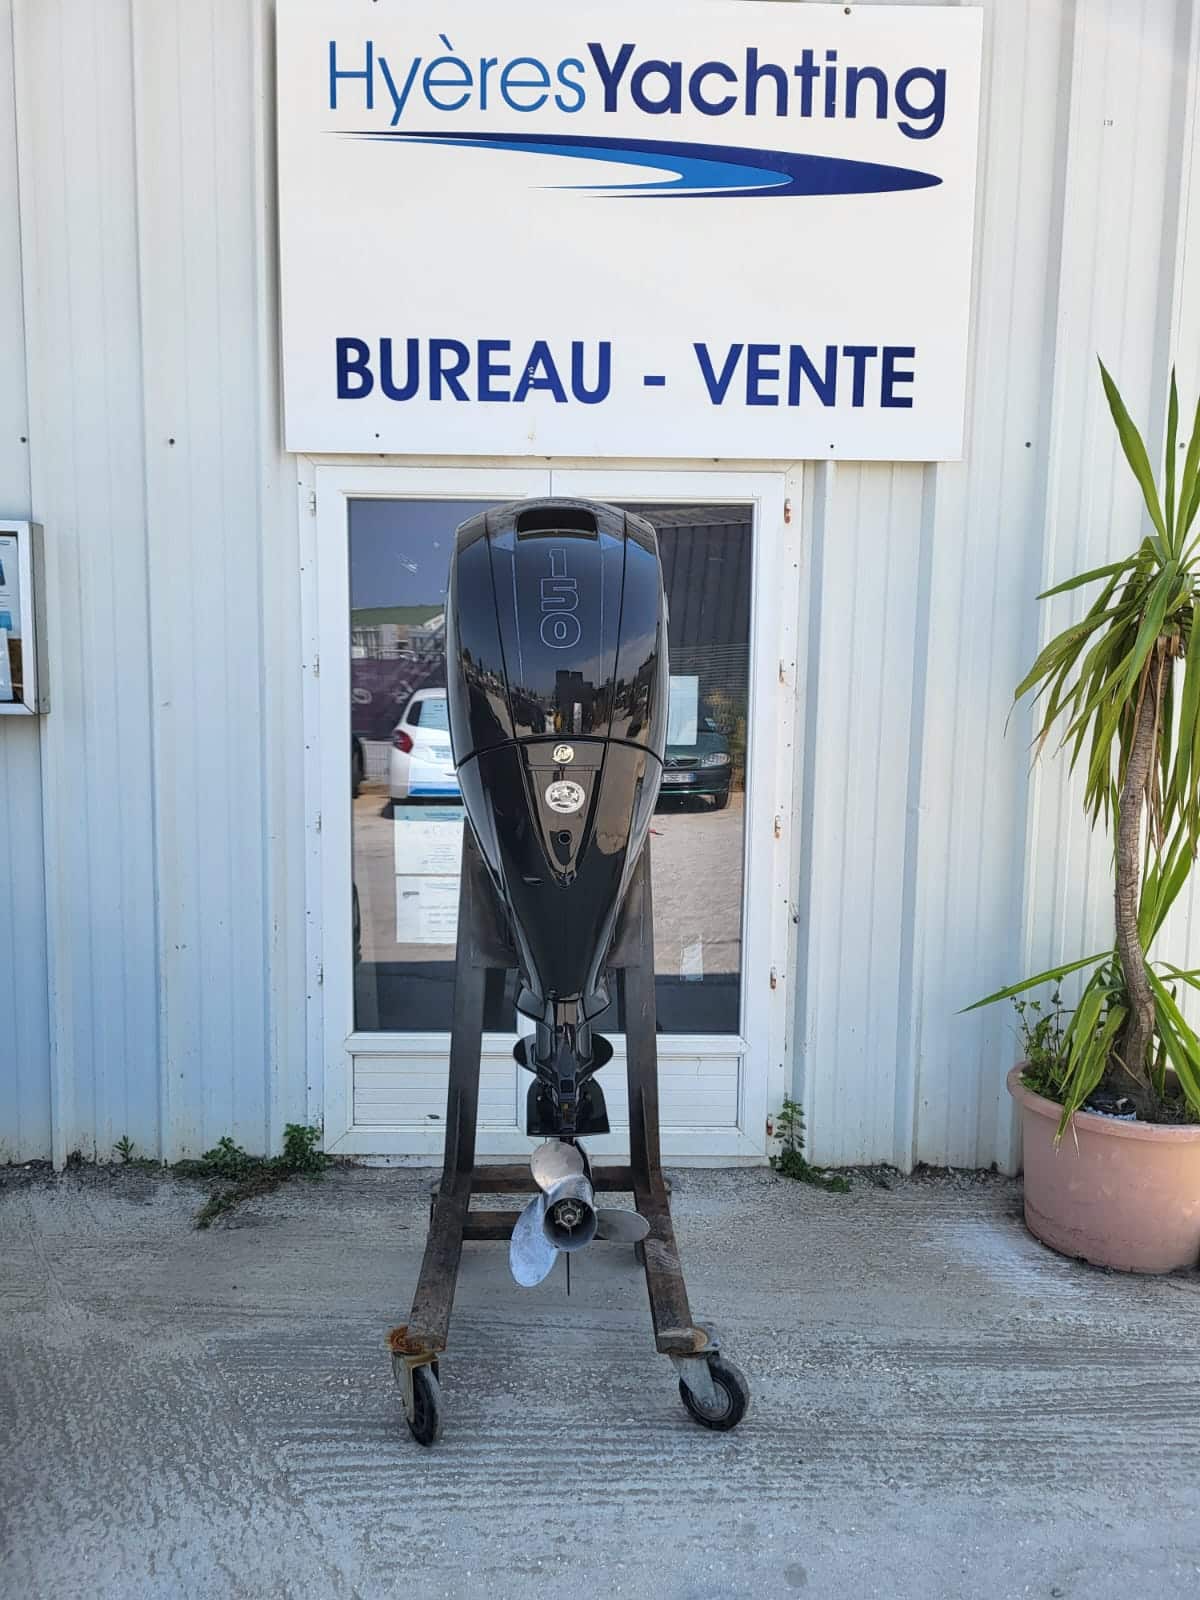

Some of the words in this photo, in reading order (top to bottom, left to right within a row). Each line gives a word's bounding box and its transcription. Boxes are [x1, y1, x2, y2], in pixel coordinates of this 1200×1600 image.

[336, 337, 612, 405] BUREAU
[694, 342, 916, 409] VENTE
[539, 547, 582, 649] 150
